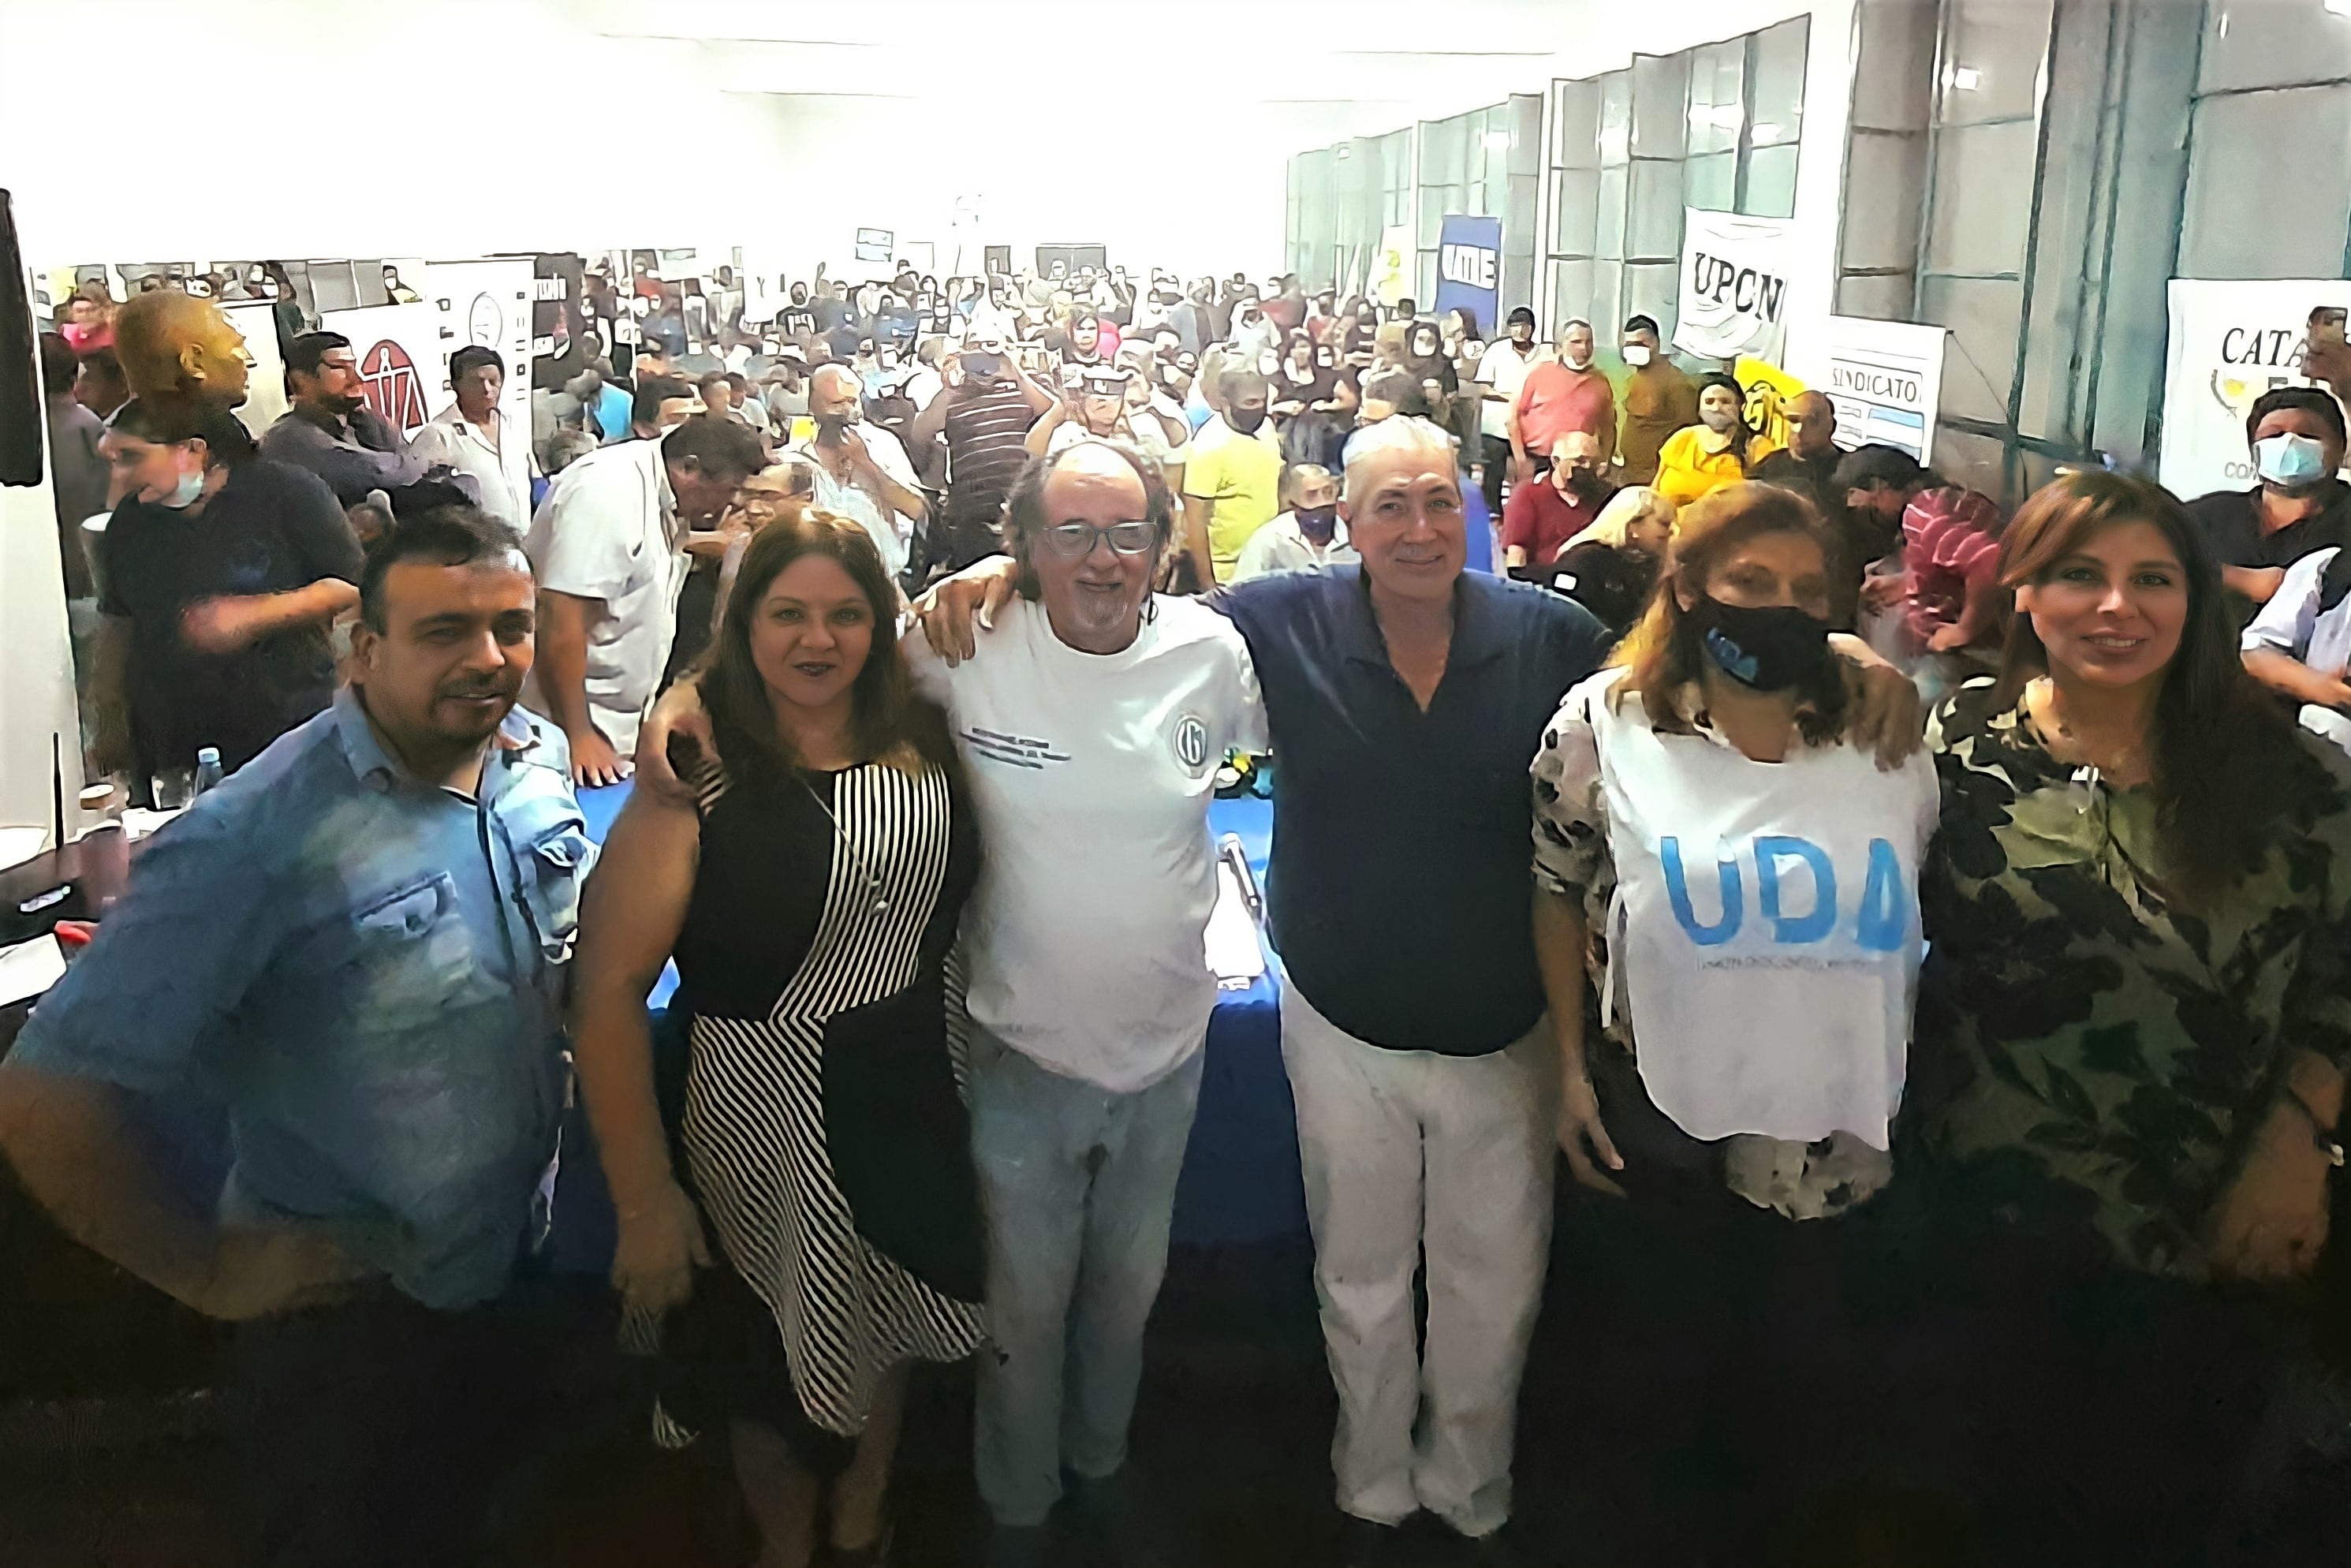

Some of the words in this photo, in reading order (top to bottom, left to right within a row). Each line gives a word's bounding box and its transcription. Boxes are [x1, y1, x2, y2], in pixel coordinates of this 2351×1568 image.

[1695, 252, 1783, 323] UPCN
[1832, 368, 1917, 403] SINDICATO
[1660, 835, 1905, 952] UDA
